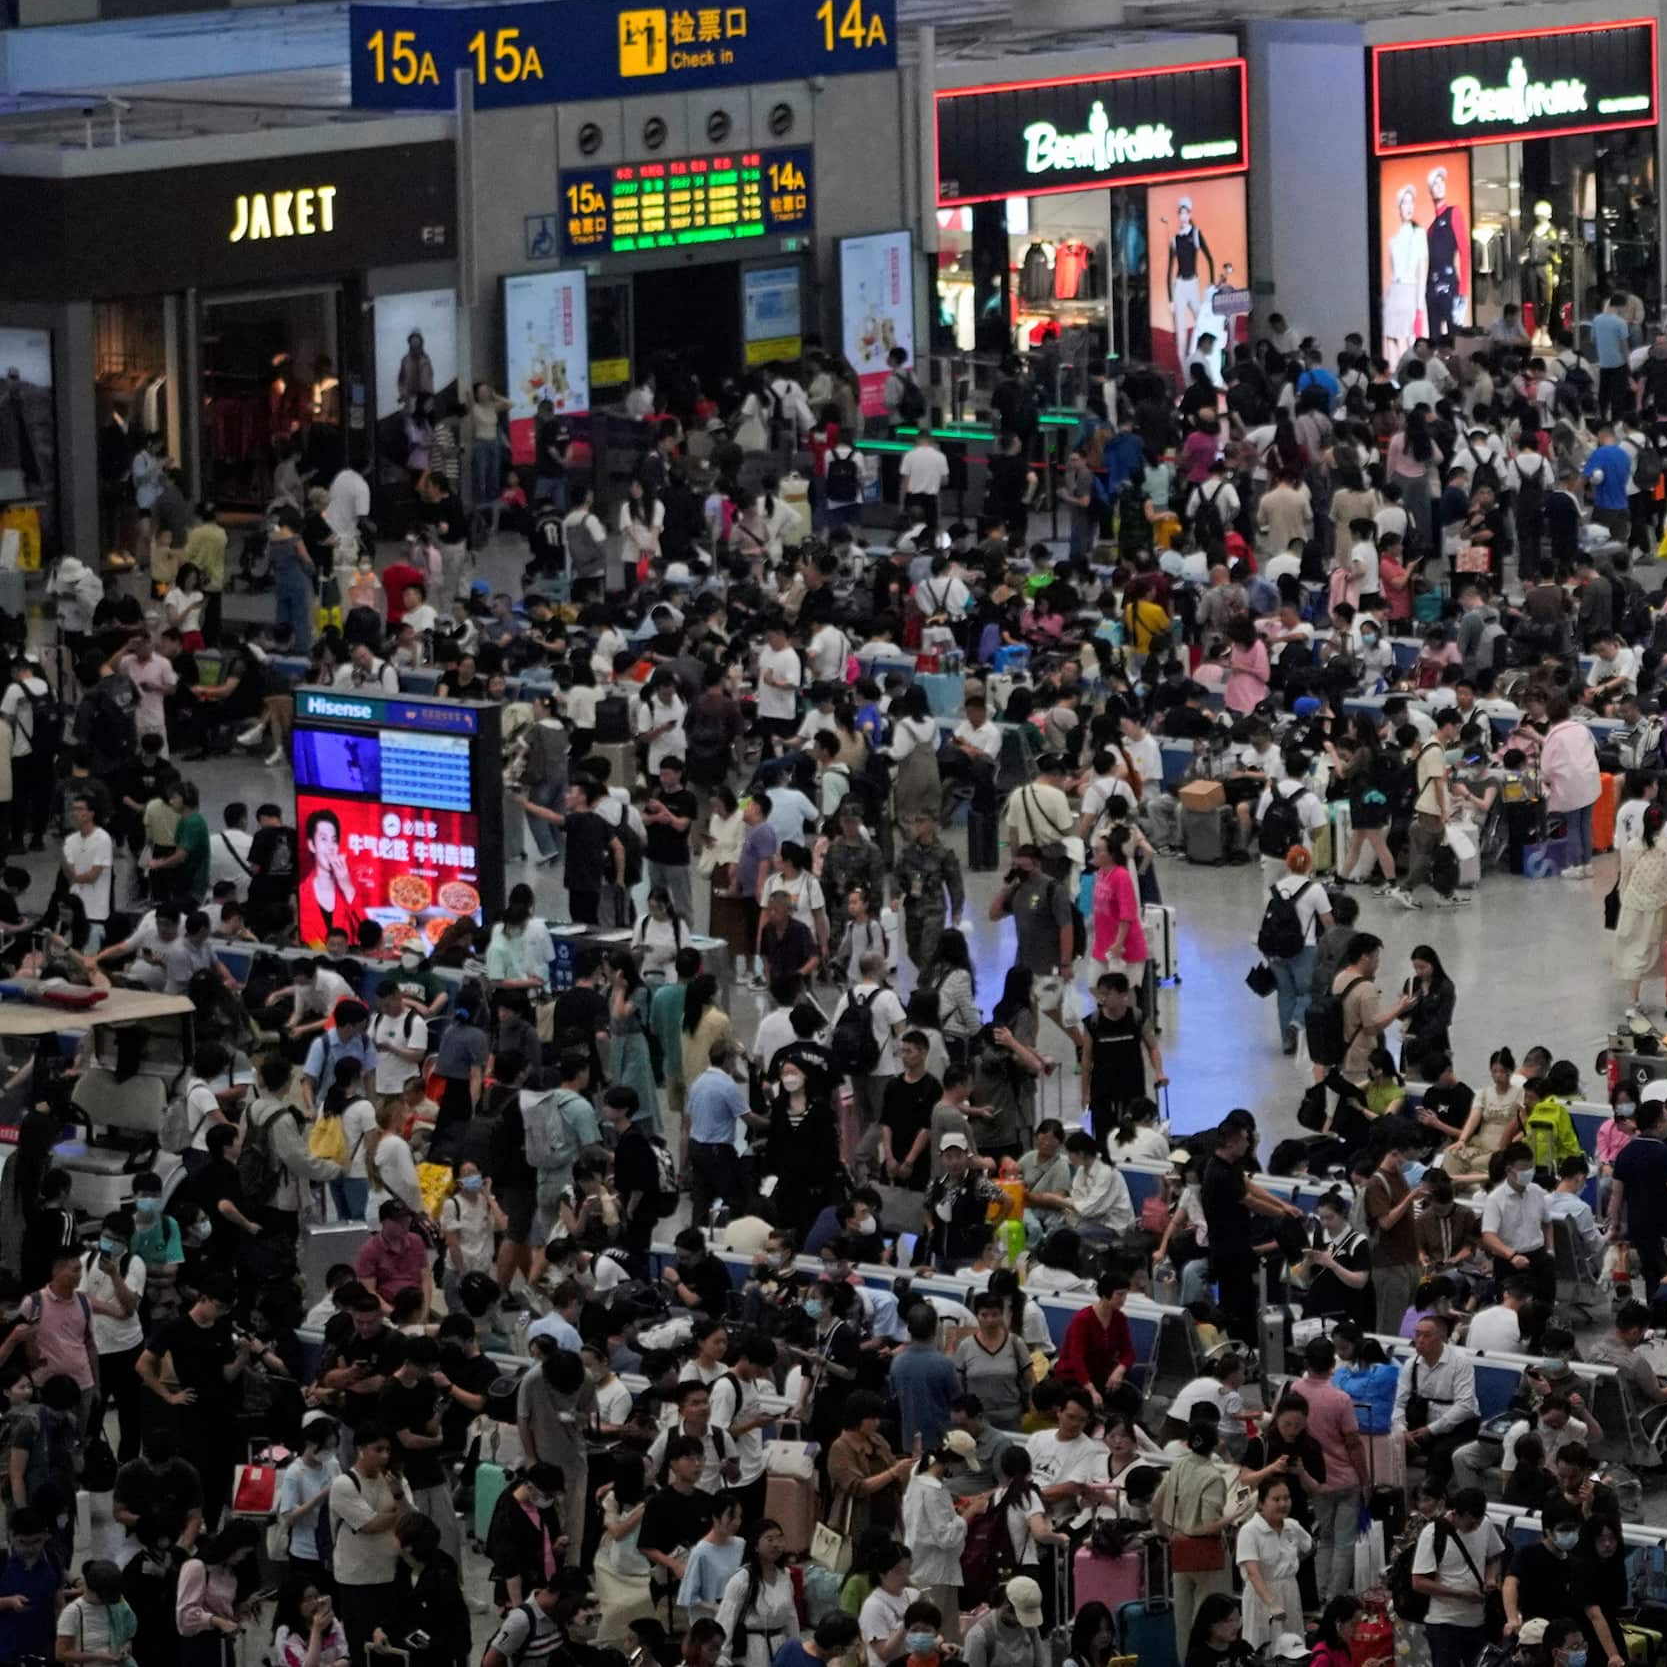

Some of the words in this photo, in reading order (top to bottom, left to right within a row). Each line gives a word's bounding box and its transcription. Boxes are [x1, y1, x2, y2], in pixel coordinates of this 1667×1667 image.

[670, 7, 748, 45] 检票口
[366, 29, 440, 86] 15A
[467, 28, 544, 86] 15A
[670, 48, 715, 71] Check
[719, 47, 734, 66] in
[229, 185, 337, 244] JAKET
[567, 182, 606, 215] 15A
[768, 161, 806, 193] 14A
[308, 696, 372, 720] Hisense
